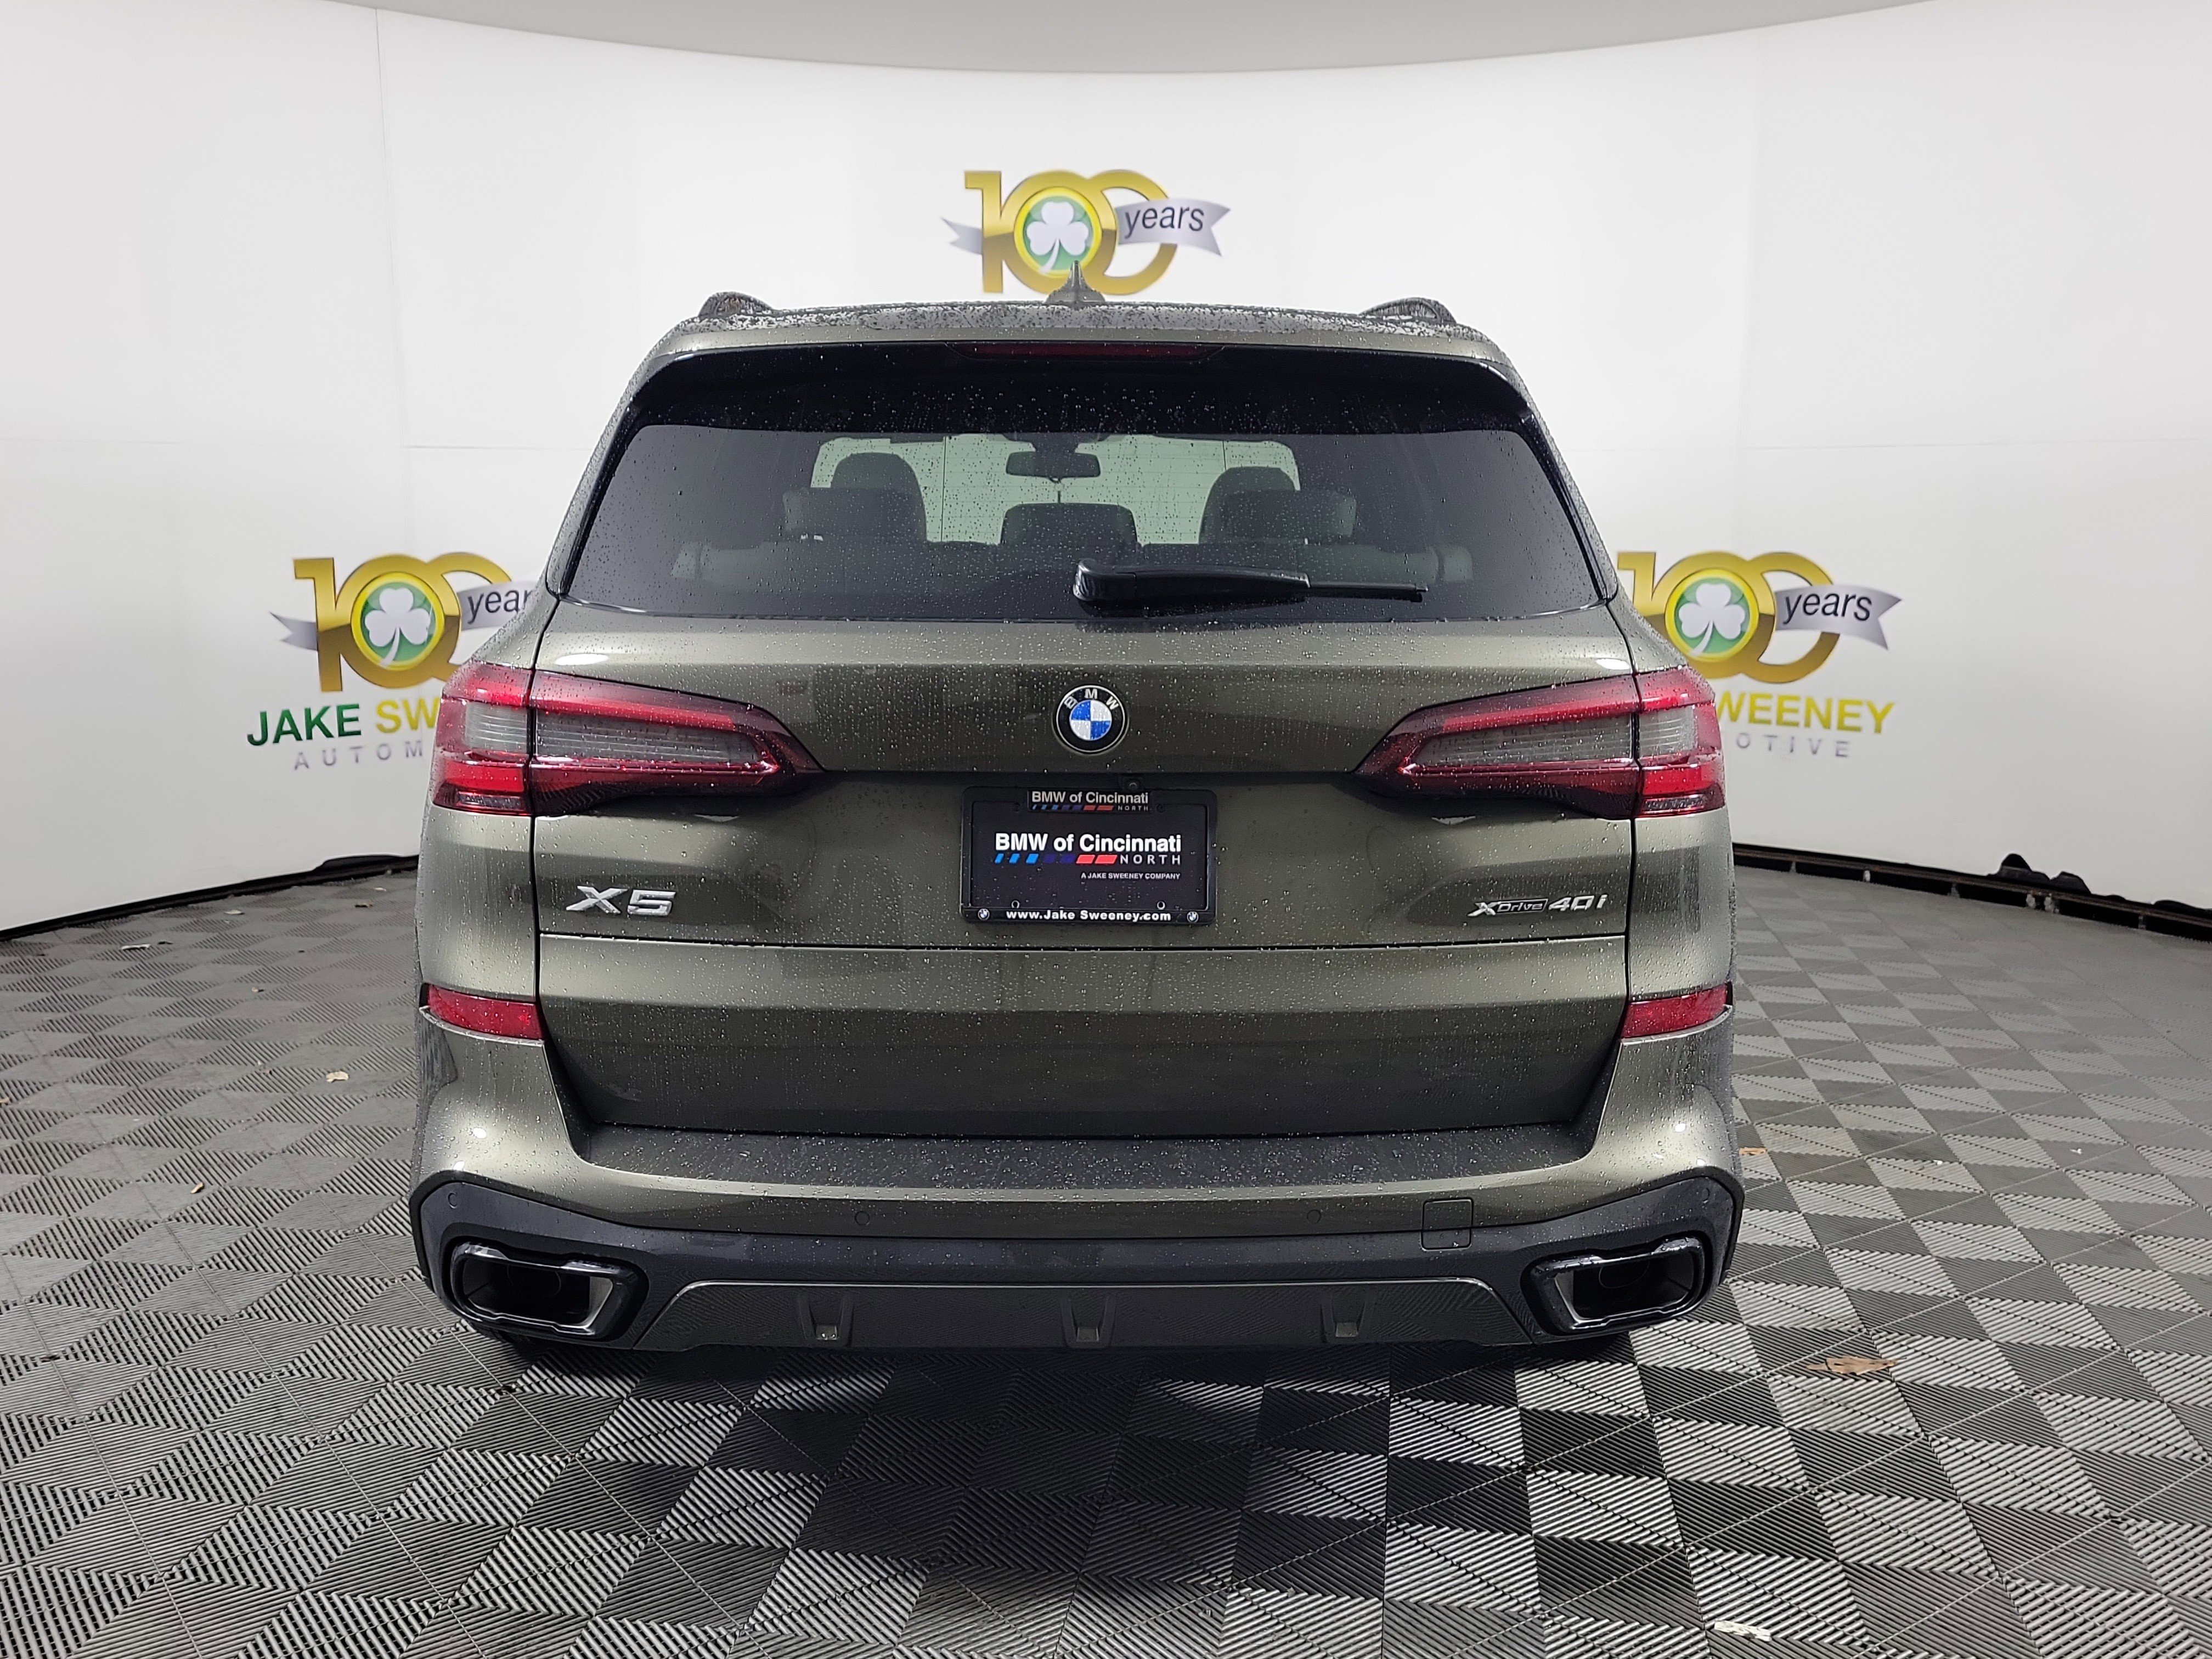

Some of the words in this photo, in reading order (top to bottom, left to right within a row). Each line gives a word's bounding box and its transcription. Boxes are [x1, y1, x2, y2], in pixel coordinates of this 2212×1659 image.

[1124, 205, 1205, 239] years
[467, 589, 533, 625] year
[1782, 591, 1872, 625] years
[1064, 688, 1120, 710] BMW
[1715, 689, 1895, 734] WEENEY
[247, 703, 362, 746] JAKE
[294, 740, 422, 771] AUTOM
[1736, 731, 1850, 758] OTIVE
[1031, 791, 1066, 803] BMW
[1069, 791, 1082, 803] of
[1085, 792, 1149, 804] Cincinnati
[995, 832, 1048, 851] BMW
[1053, 833, 1075, 851] of
[1079, 834, 1182, 853] Cincinnati
[1120, 854, 1181, 865] NORTH
[566, 885, 677, 916] X5
[1080, 910, 1172, 922] Sweeney.com
